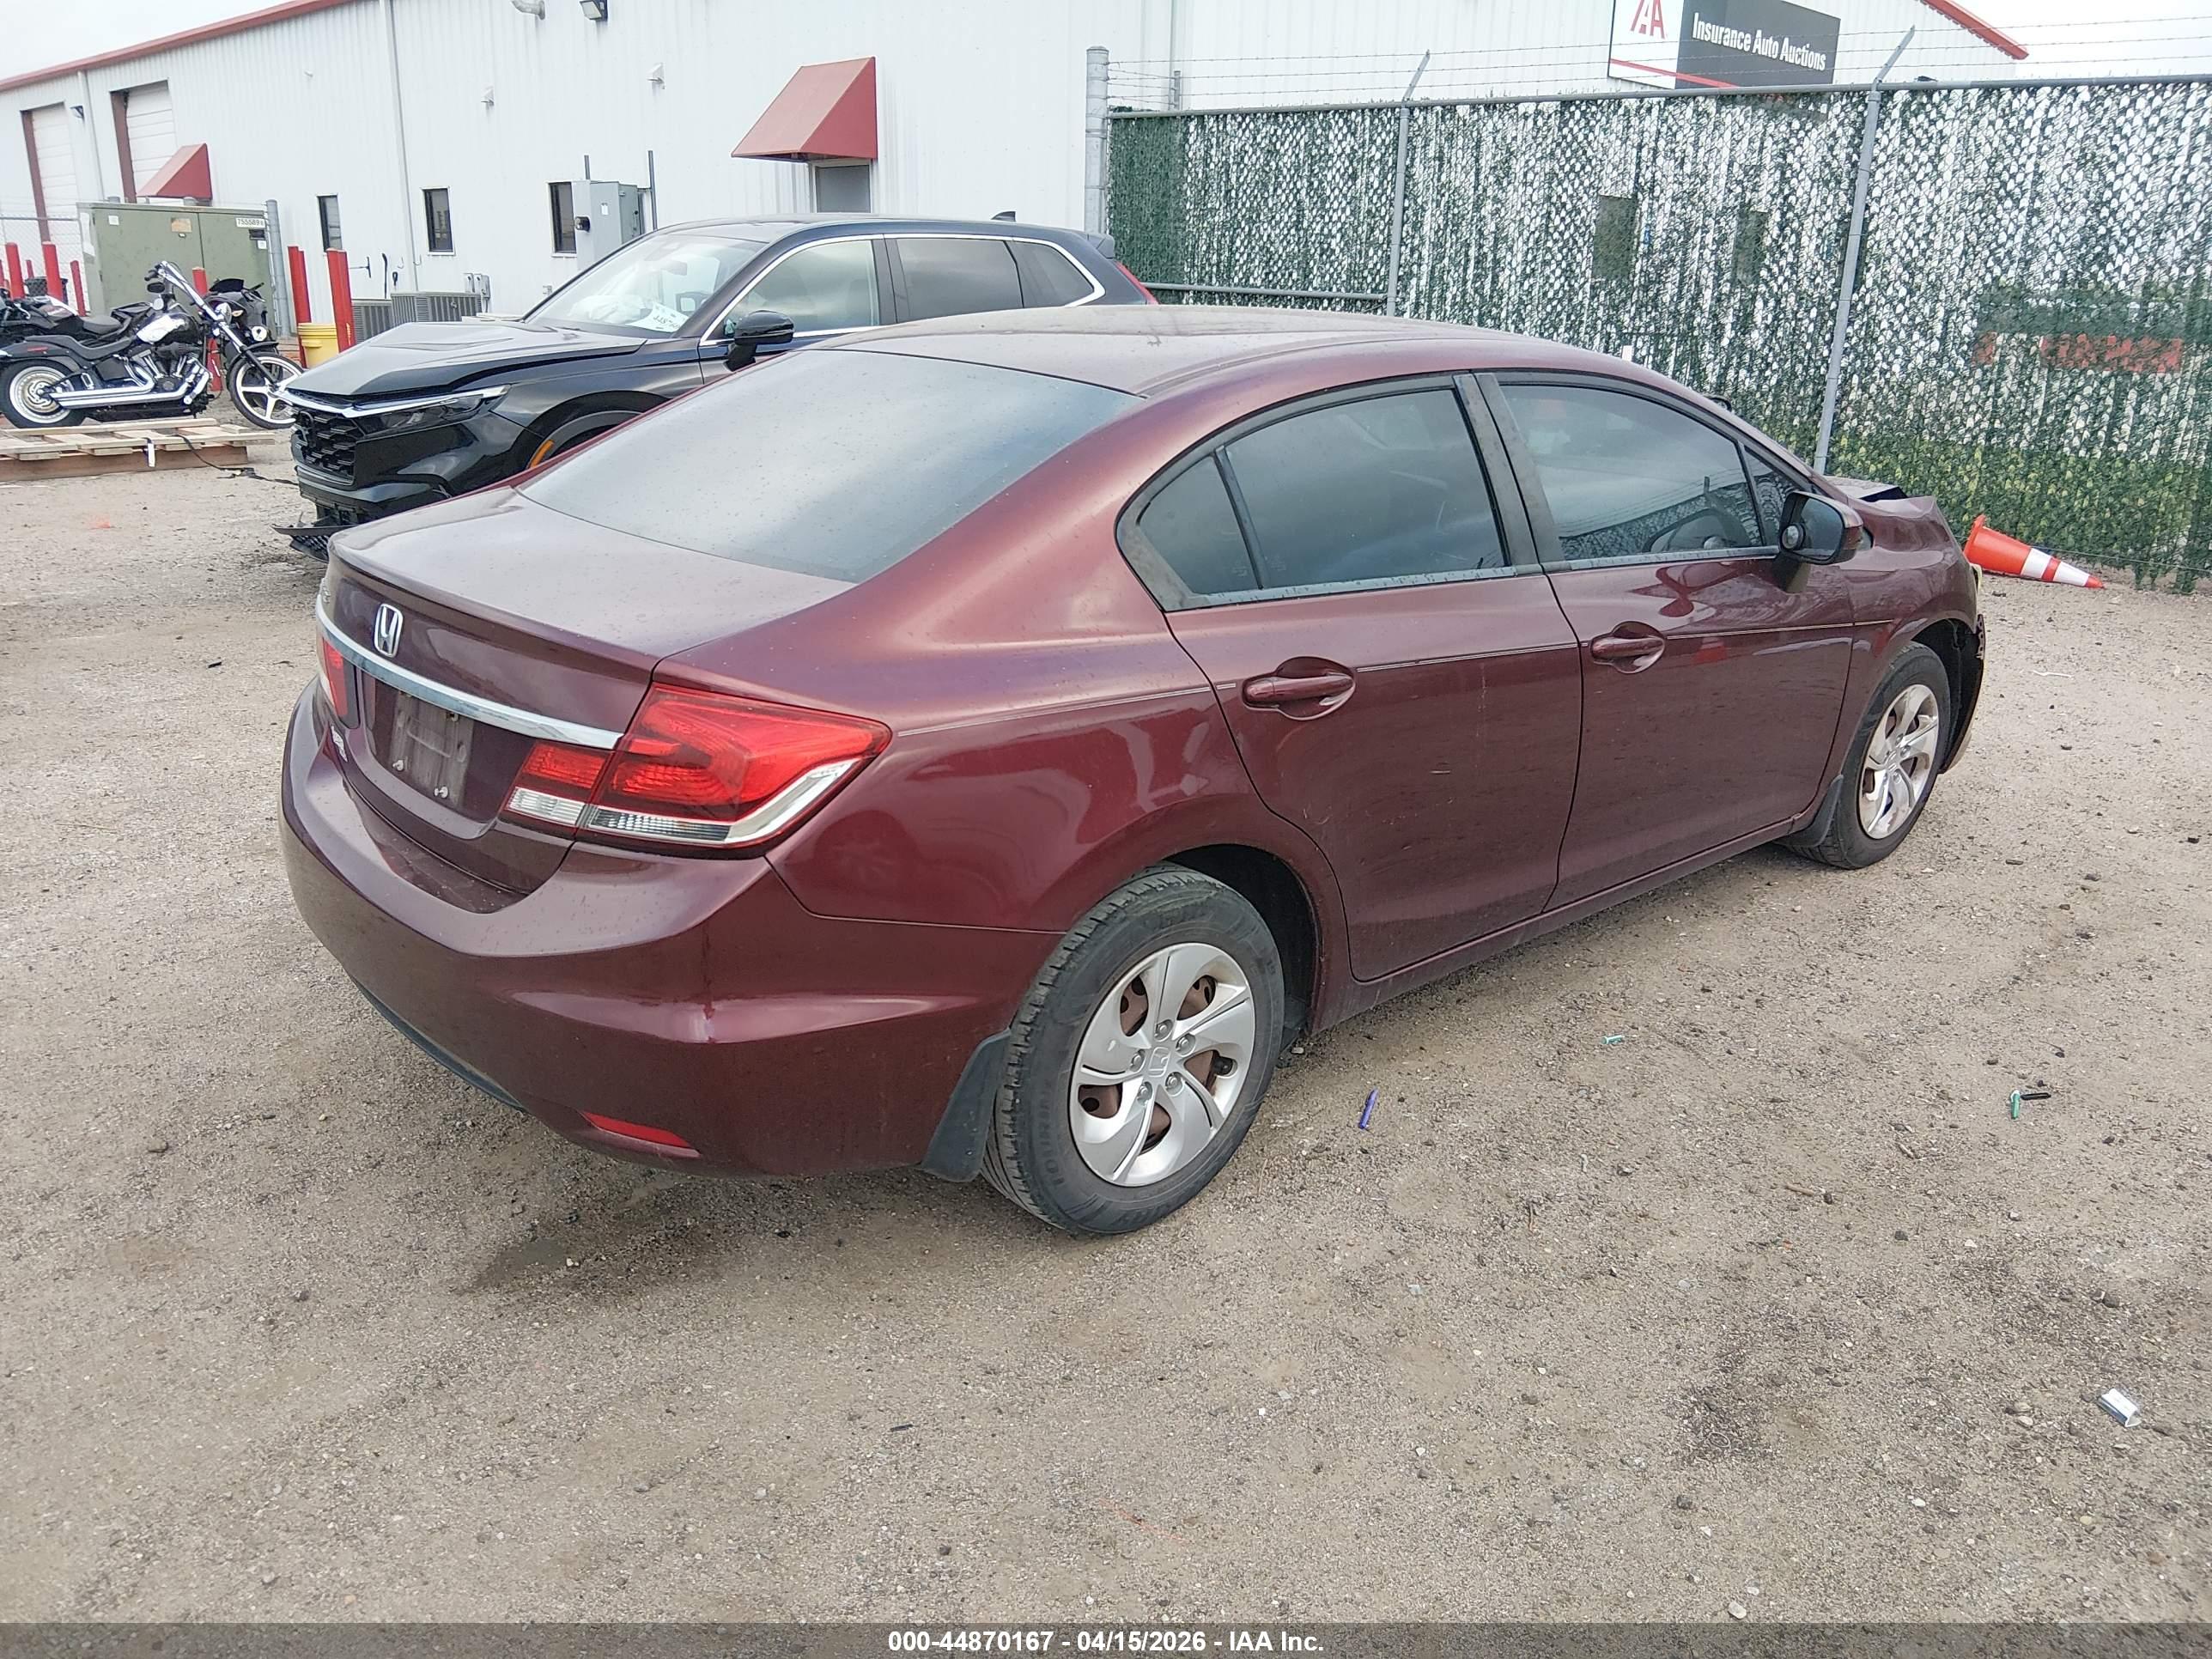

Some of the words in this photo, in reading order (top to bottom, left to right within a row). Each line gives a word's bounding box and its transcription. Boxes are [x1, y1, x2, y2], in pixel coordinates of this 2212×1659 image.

[1692, 12, 1752, 52] Insurance
[1752, 29, 1779, 59] Auto
[1779, 37, 1826, 71] Auctions
